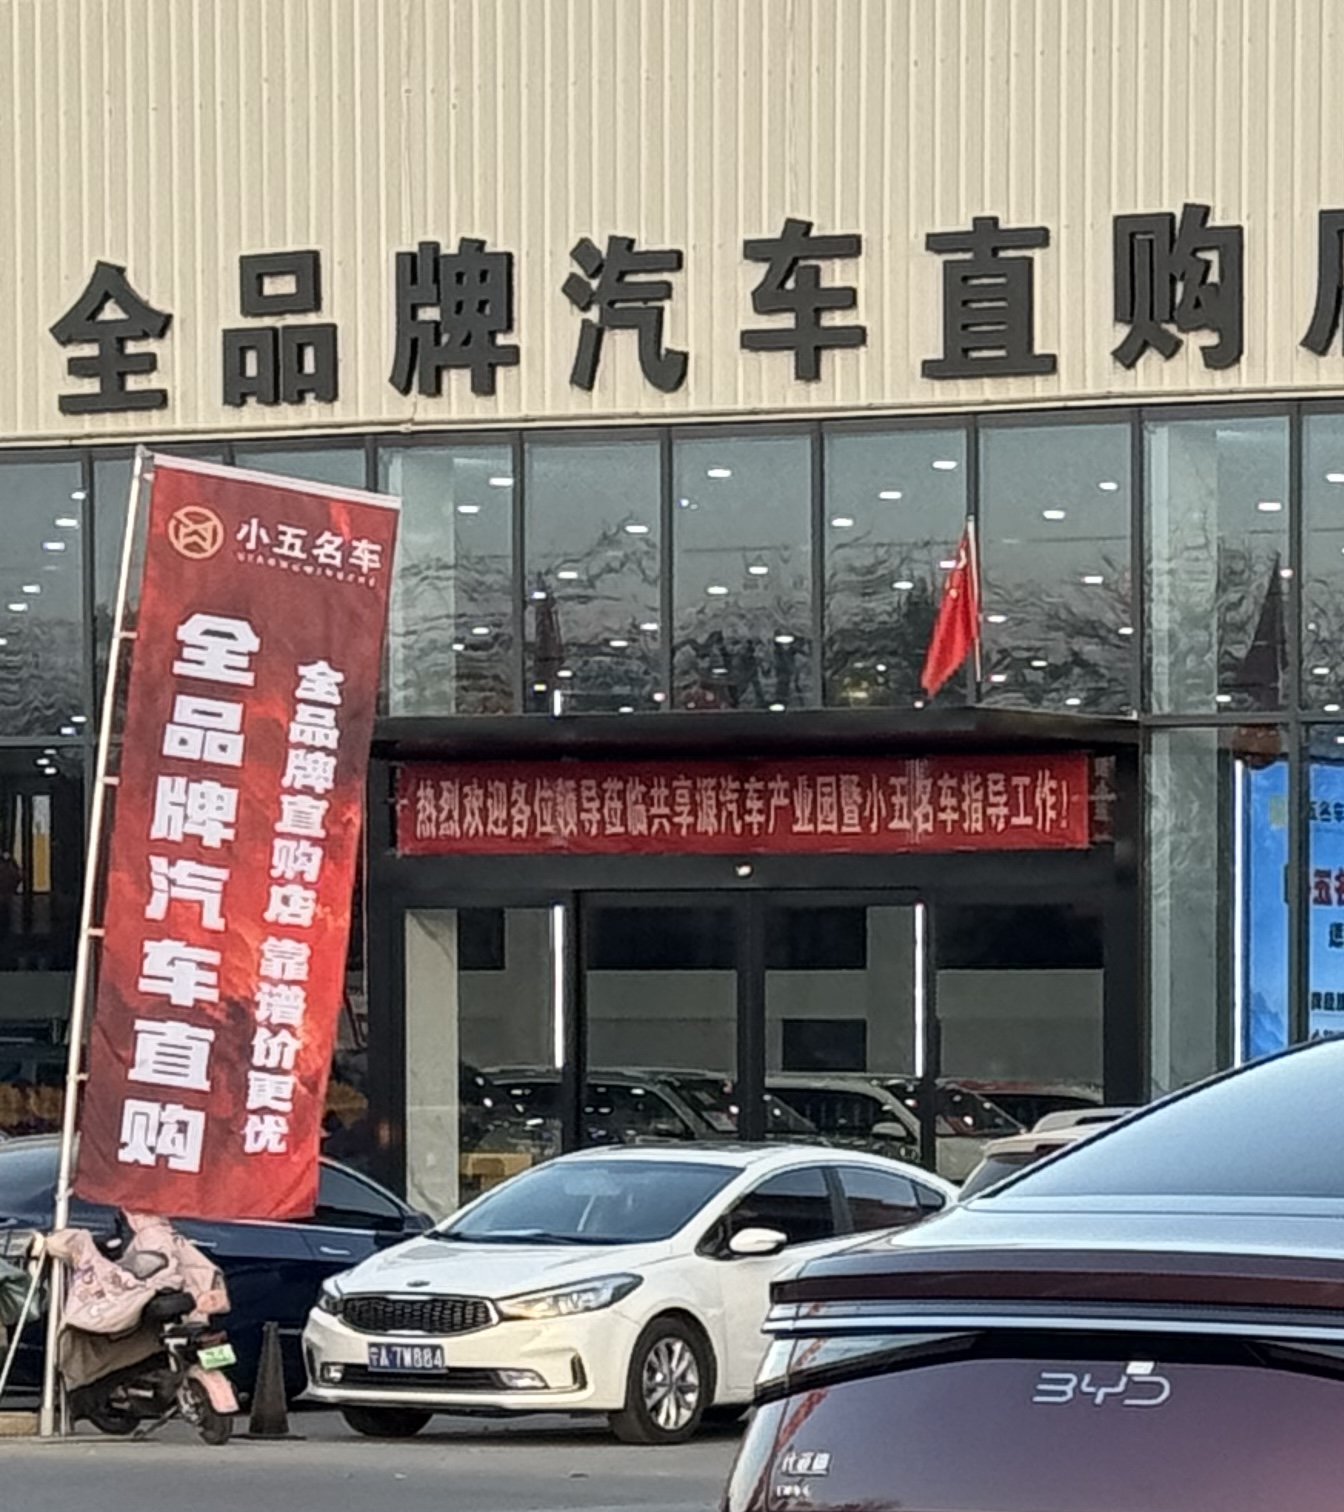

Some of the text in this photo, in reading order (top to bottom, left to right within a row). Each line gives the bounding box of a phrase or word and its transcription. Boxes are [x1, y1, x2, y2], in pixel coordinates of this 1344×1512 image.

[236, 517, 382, 574] 小五名车
[263, 659, 345, 928] 全品牌直购店
[118, 612, 261, 1173] 全品牌汽车直购
[1032, 1371, 1170, 1405] BYD
